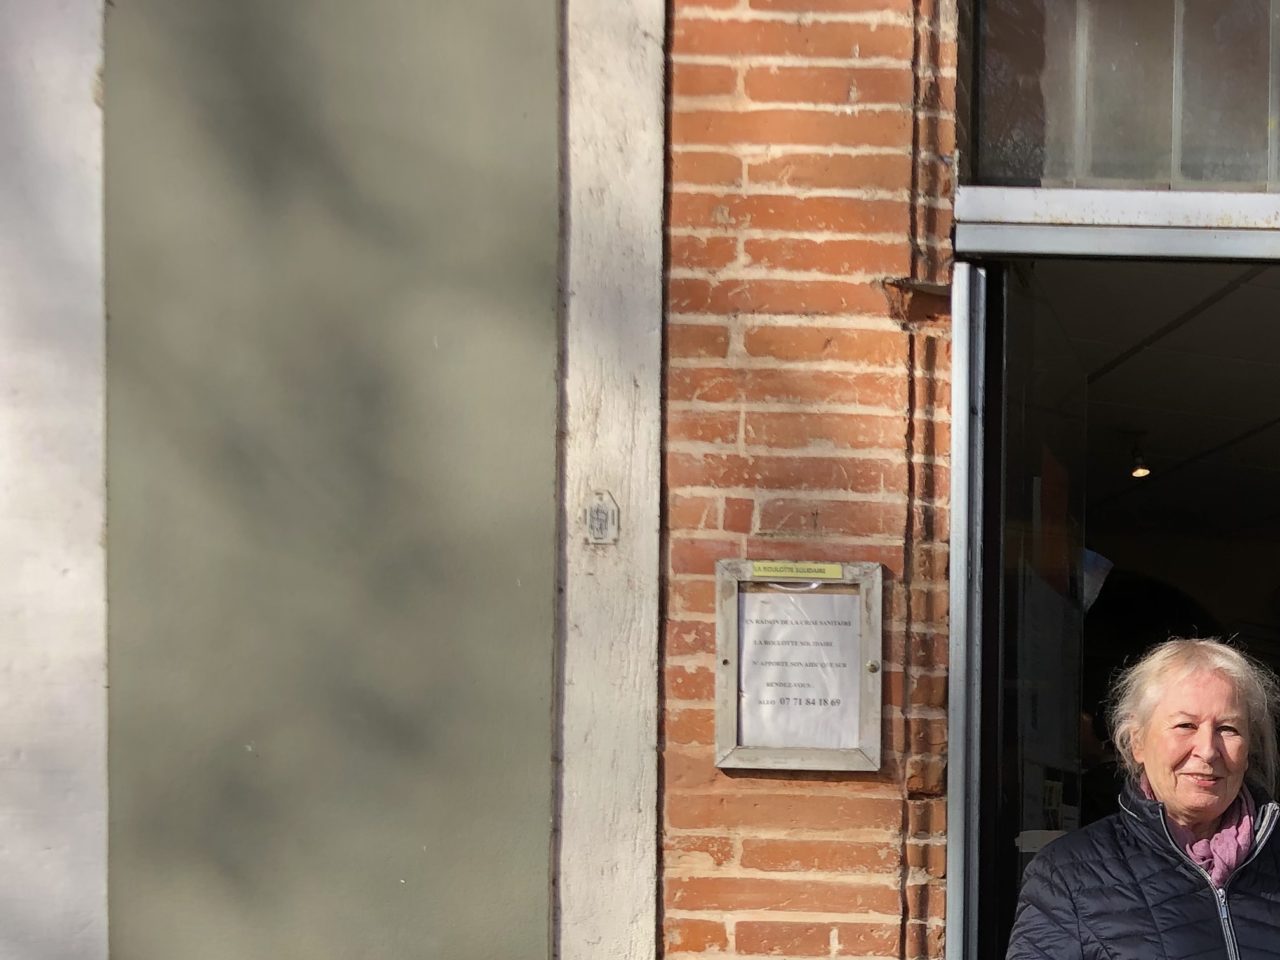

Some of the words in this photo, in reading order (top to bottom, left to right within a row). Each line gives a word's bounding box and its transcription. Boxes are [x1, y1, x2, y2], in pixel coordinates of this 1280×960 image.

[779, 697, 791, 706] 07
[793, 697, 804, 706] 71
[805, 697, 817, 707] 84
[830, 698, 842, 708] 69
